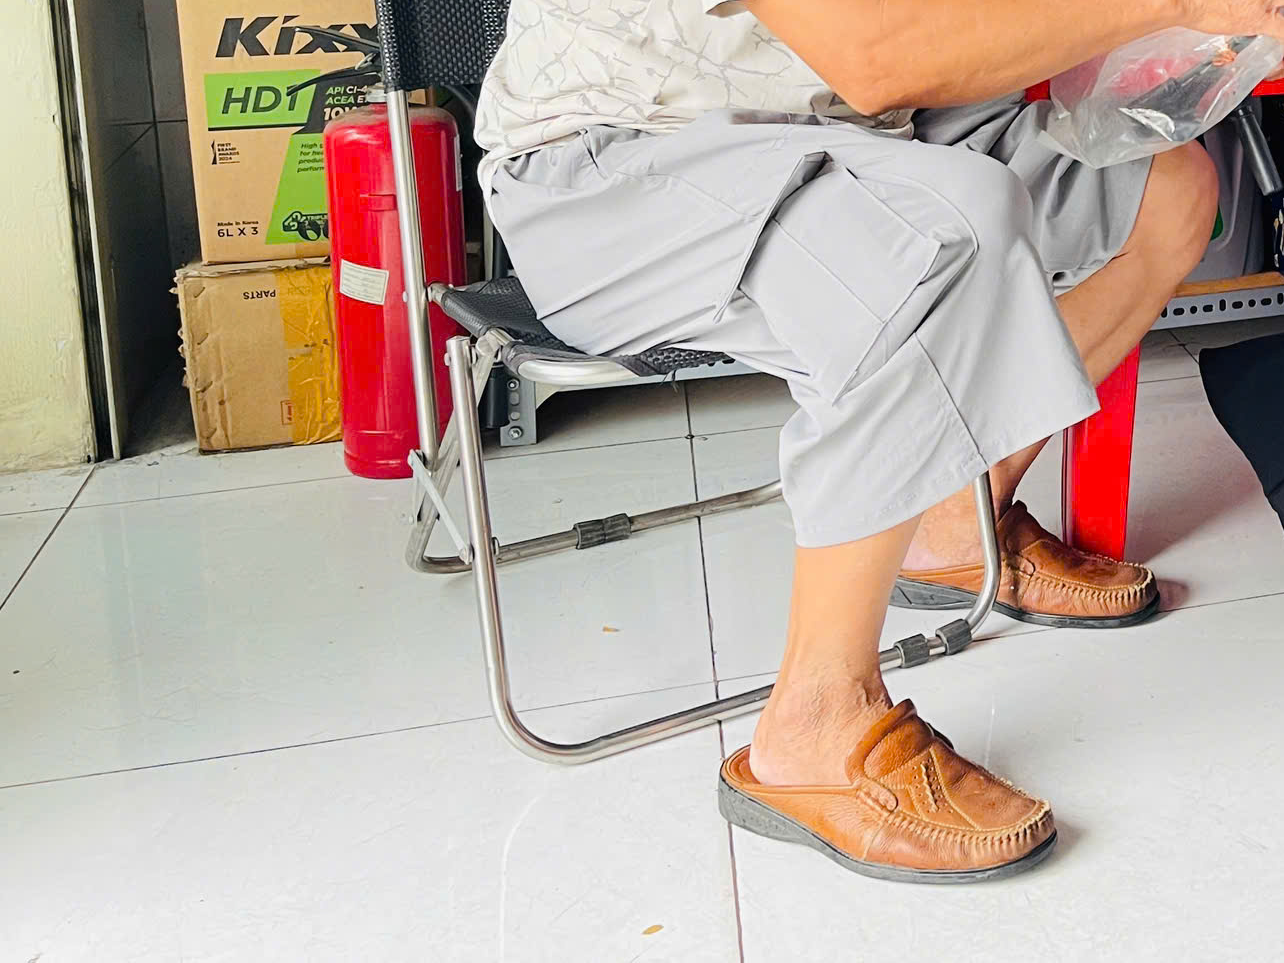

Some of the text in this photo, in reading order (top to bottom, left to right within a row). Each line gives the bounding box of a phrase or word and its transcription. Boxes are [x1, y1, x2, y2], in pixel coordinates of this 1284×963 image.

[326, 86, 345, 96] API
[326, 94, 356, 106] ACEA
[300, 142, 318, 150] High
[217, 226, 260, 238] 6L X 3
[243, 289, 276, 300] PARTS
